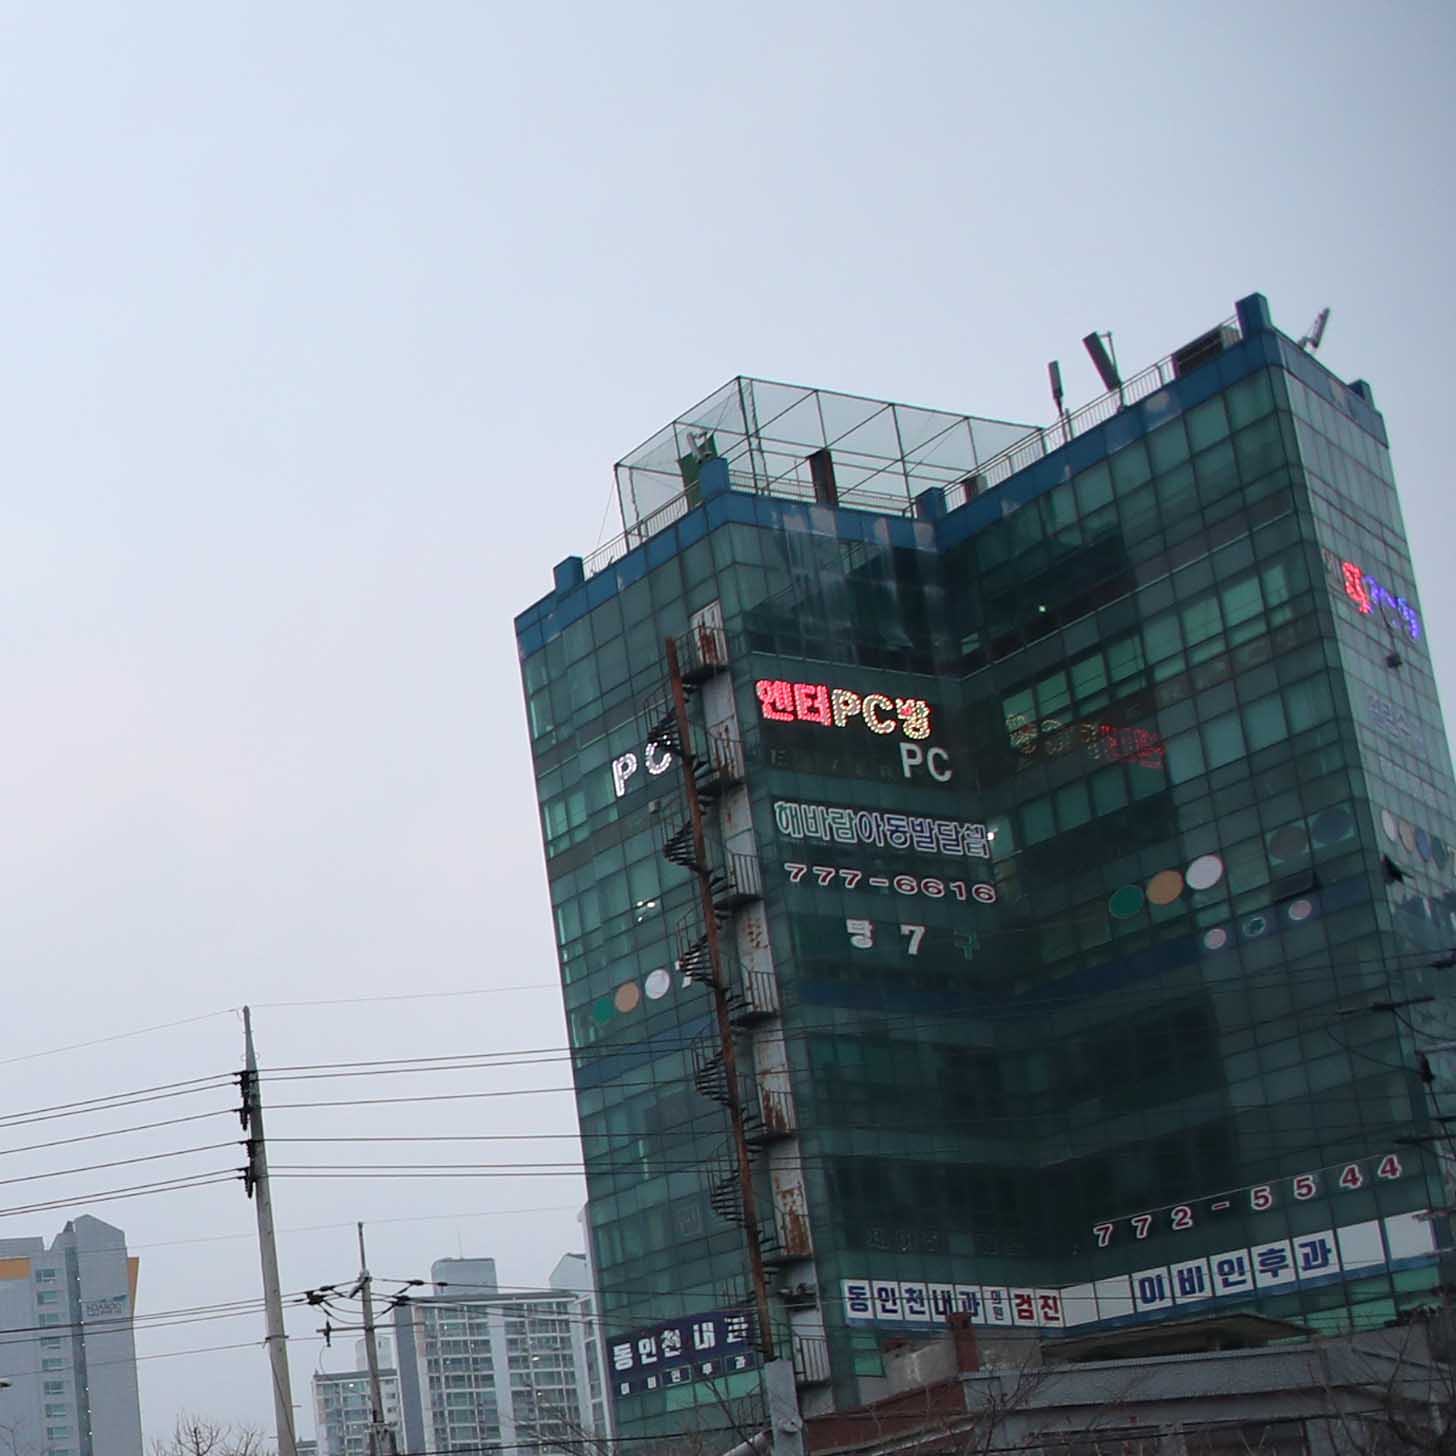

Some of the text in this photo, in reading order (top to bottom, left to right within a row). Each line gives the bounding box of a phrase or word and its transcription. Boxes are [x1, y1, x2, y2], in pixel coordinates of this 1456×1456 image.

[612, 734, 673, 797] PC
[899, 742, 952, 782] PC
[784, 863, 997, 903] 777-6616
[1093, 1154, 1402, 1247] 772-5544
[1139, 1238, 1332, 1305] 이비인후과
[847, 1285, 981, 1318] 동인천내과
[1014, 1293, 1060, 1321] 검진
